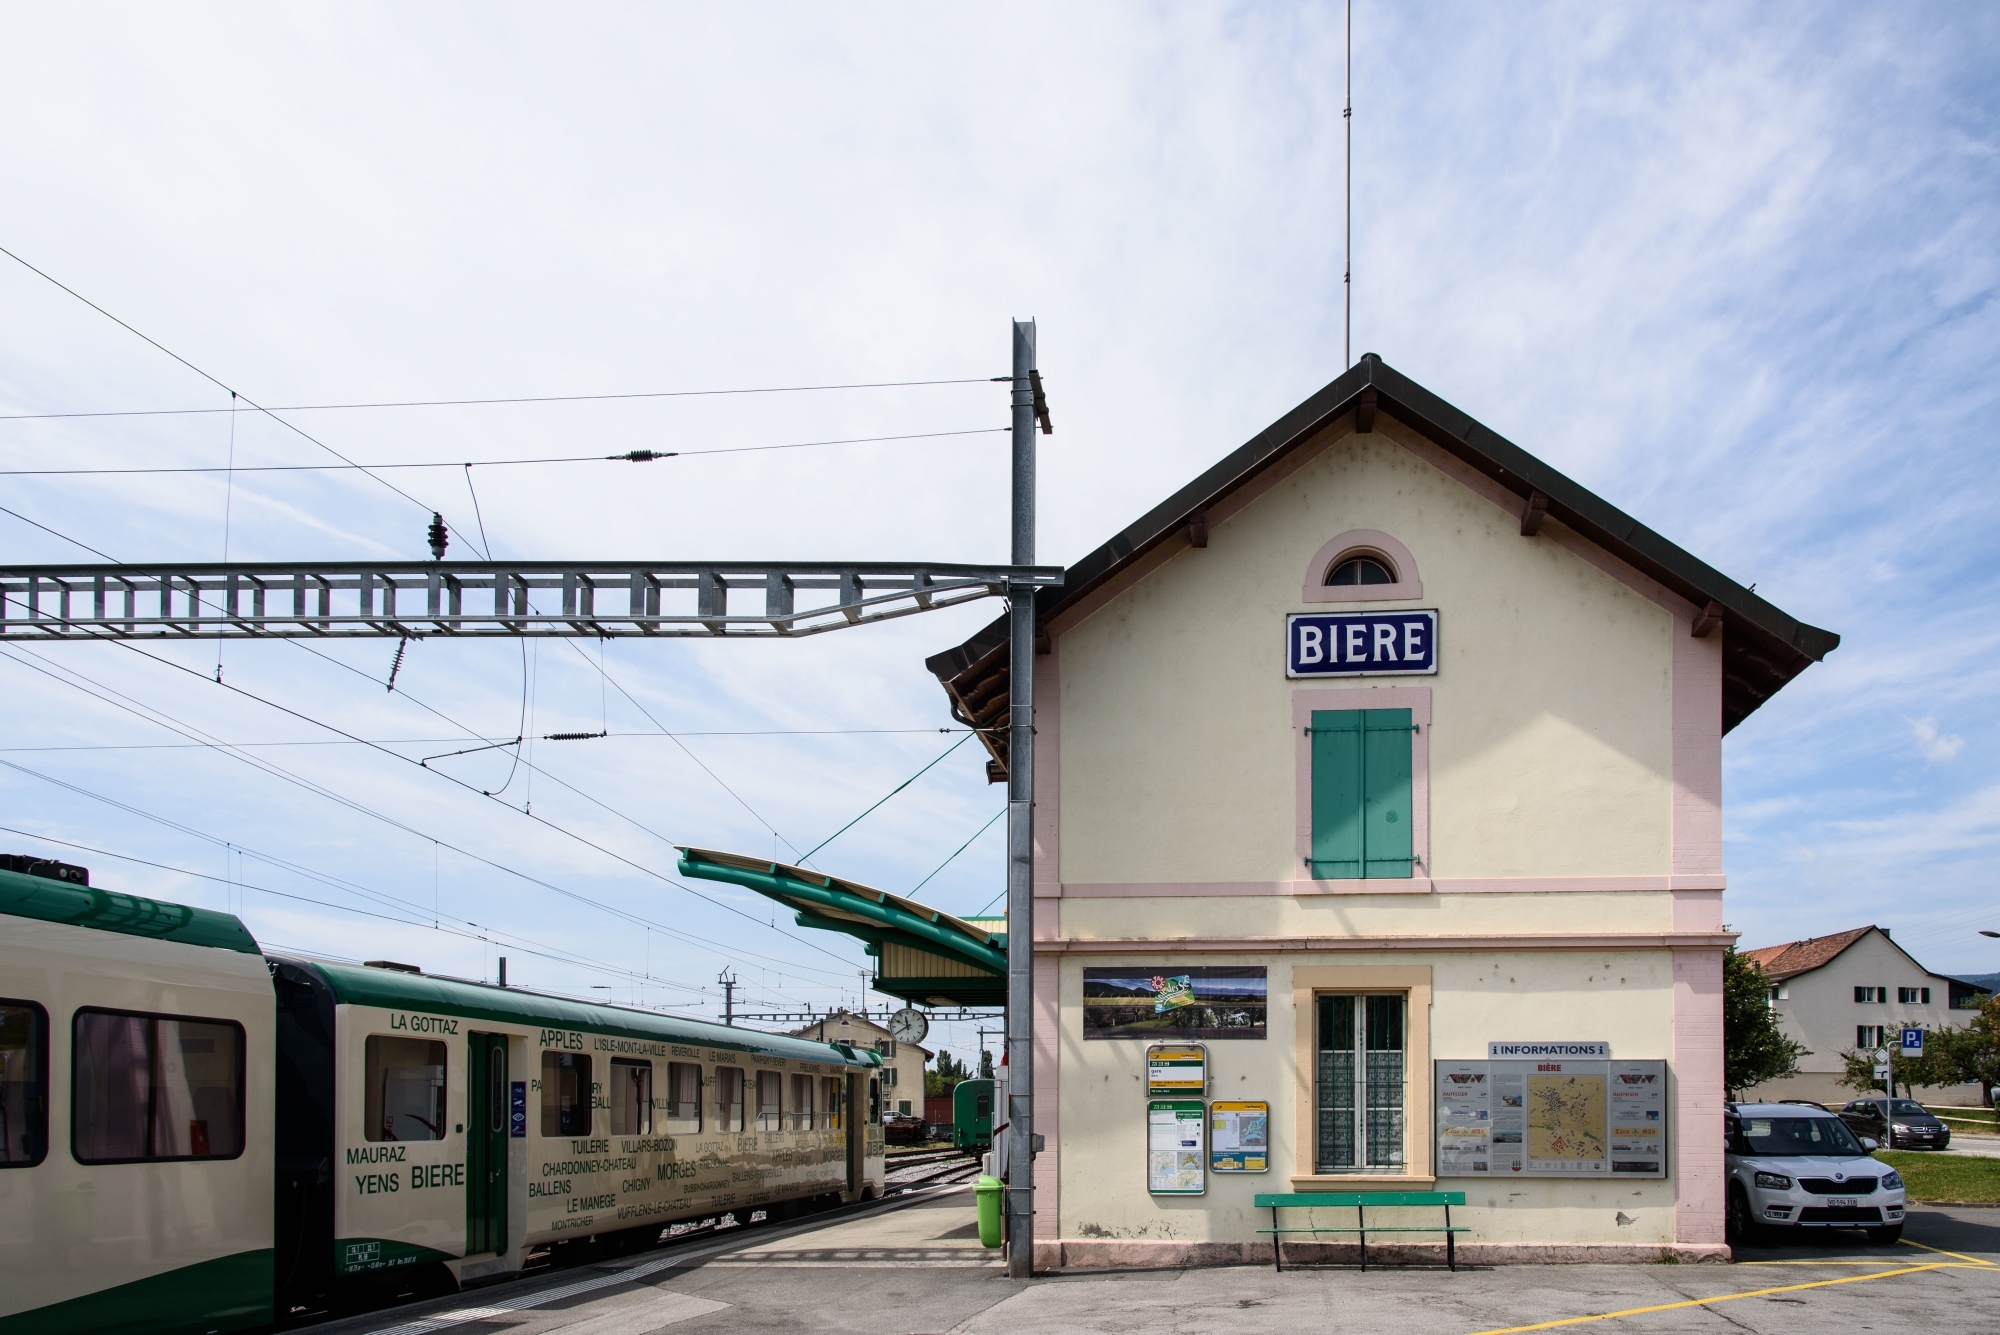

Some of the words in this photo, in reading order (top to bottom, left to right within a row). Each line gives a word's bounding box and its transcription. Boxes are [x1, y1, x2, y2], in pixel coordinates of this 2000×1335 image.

[1299, 622, 1426, 664] BIERE
[391, 1013, 407, 1030] LA
[411, 1016, 458, 1034] GOTTAZ
[540, 1029, 583, 1050] APPLES
[1907, 1031, 1916, 1046] P
[594, 1038, 666, 1056] L'ISLE-MONT-LA-VILLE
[672, 1046, 700, 1058] REVEROLLE
[1501, 1046, 1596, 1055] INFORMATIONS
[708, 1051, 716, 1062] LE
[717, 1053, 736, 1064] MARAIS
[1538, 1063, 1561, 1071] BIÈRE
[571, 1139, 609, 1155] TUILERIE
[621, 1138, 678, 1154] VILLARS-BOZON
[696, 1142, 703, 1153] LA
[704, 1141, 724, 1152] GOTTAZ
[737, 1137, 758, 1152] BIERE
[347, 1146, 406, 1164] MAURAZ
[772, 1147, 793, 1163] APPLES
[823, 1150, 844, 1163] MORGES
[542, 1157, 637, 1177] CHARDONNEY-CHATEAU
[658, 1162, 697, 1181] MORGES
[355, 1173, 399, 1195] YENS
[412, 1163, 465, 1189] BIERE
[529, 1180, 572, 1198] BALLENS
[622, 1178, 651, 1193] CHIGNY
[683, 1180, 730, 1194] BUSSY-CHARDONNEY
[567, 1198, 578, 1213] LE
[580, 1193, 616, 1211] MANEGE
[711, 1193, 736, 1207] TUILERIE
[617, 1197, 692, 1220] VUFFLENS-LE-CHATEAU
[551, 1215, 594, 1231] MONTRICHER
